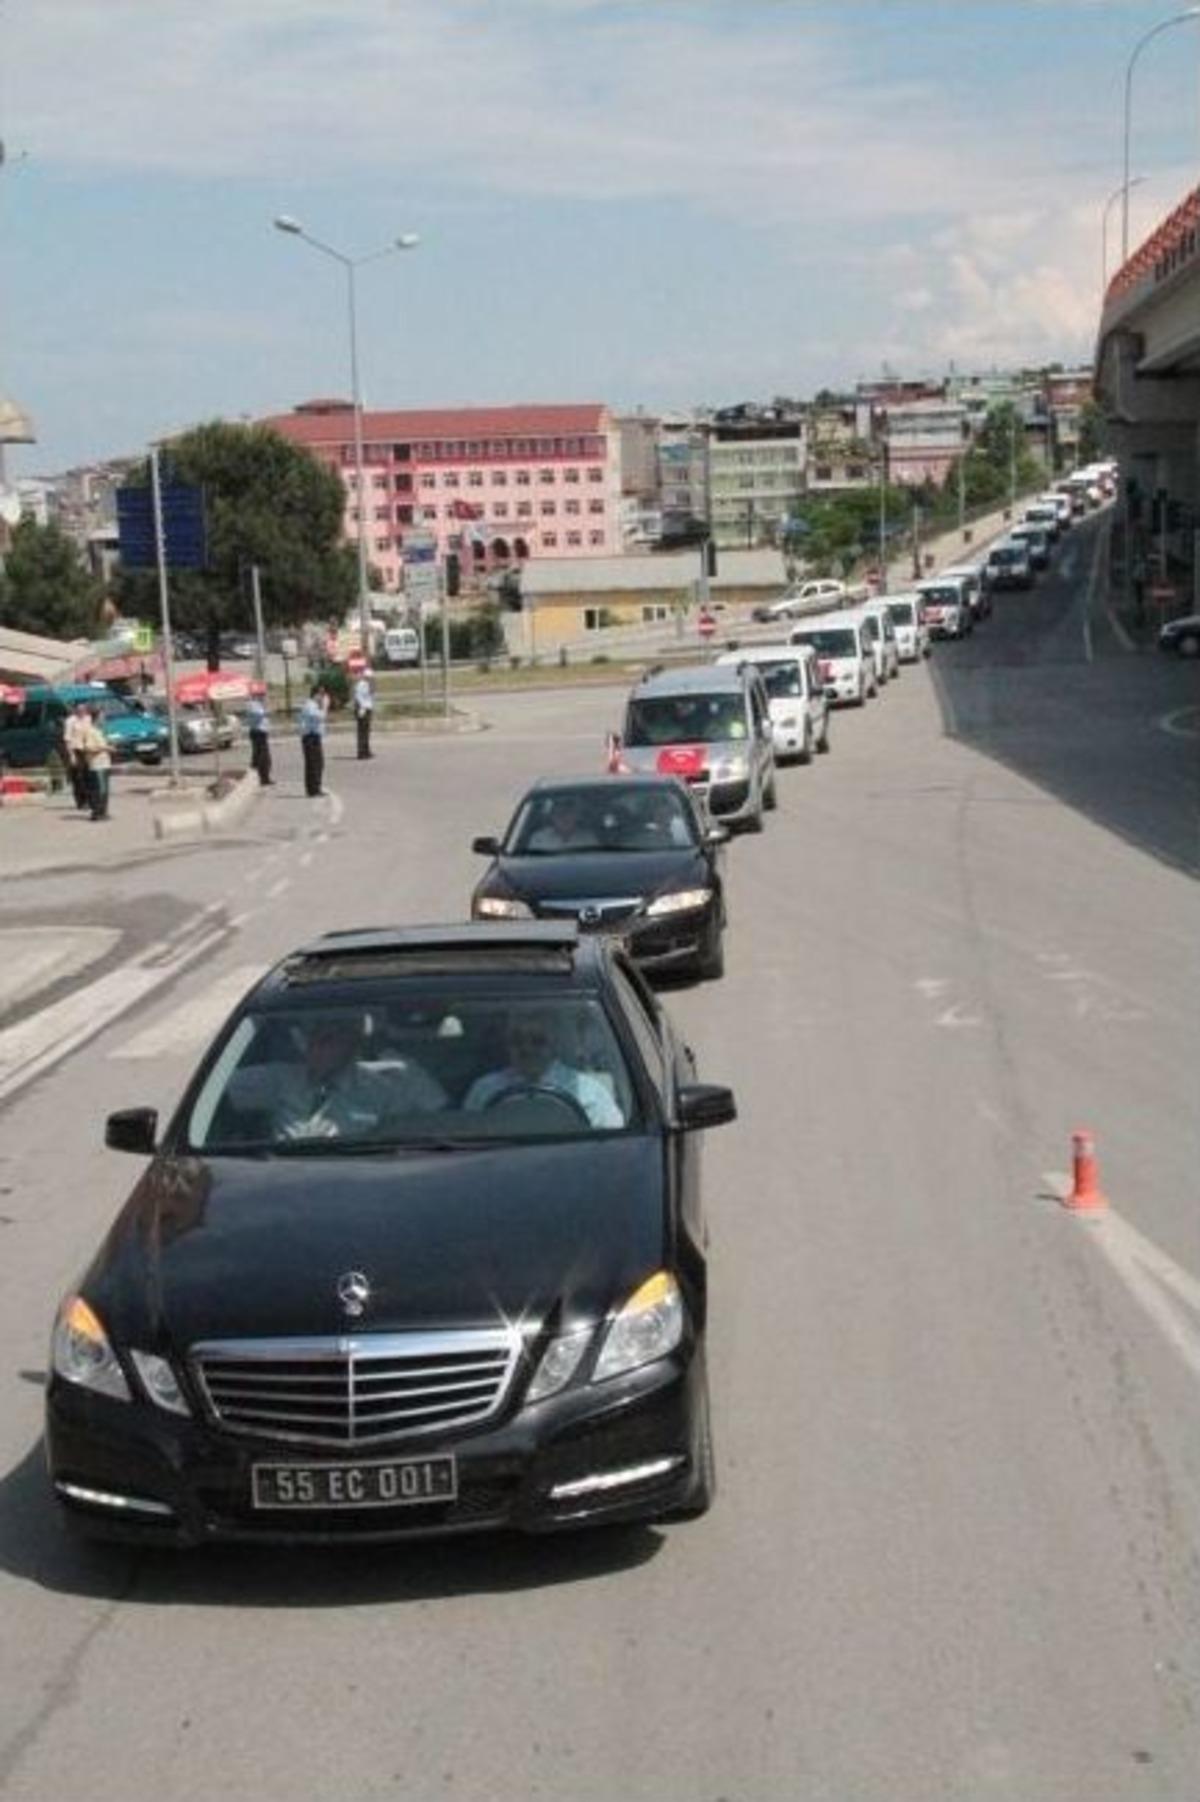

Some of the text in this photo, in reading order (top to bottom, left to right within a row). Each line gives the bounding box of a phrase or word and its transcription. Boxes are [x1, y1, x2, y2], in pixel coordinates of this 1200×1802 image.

[276, 1464, 433, 1500] 55 EC 001
